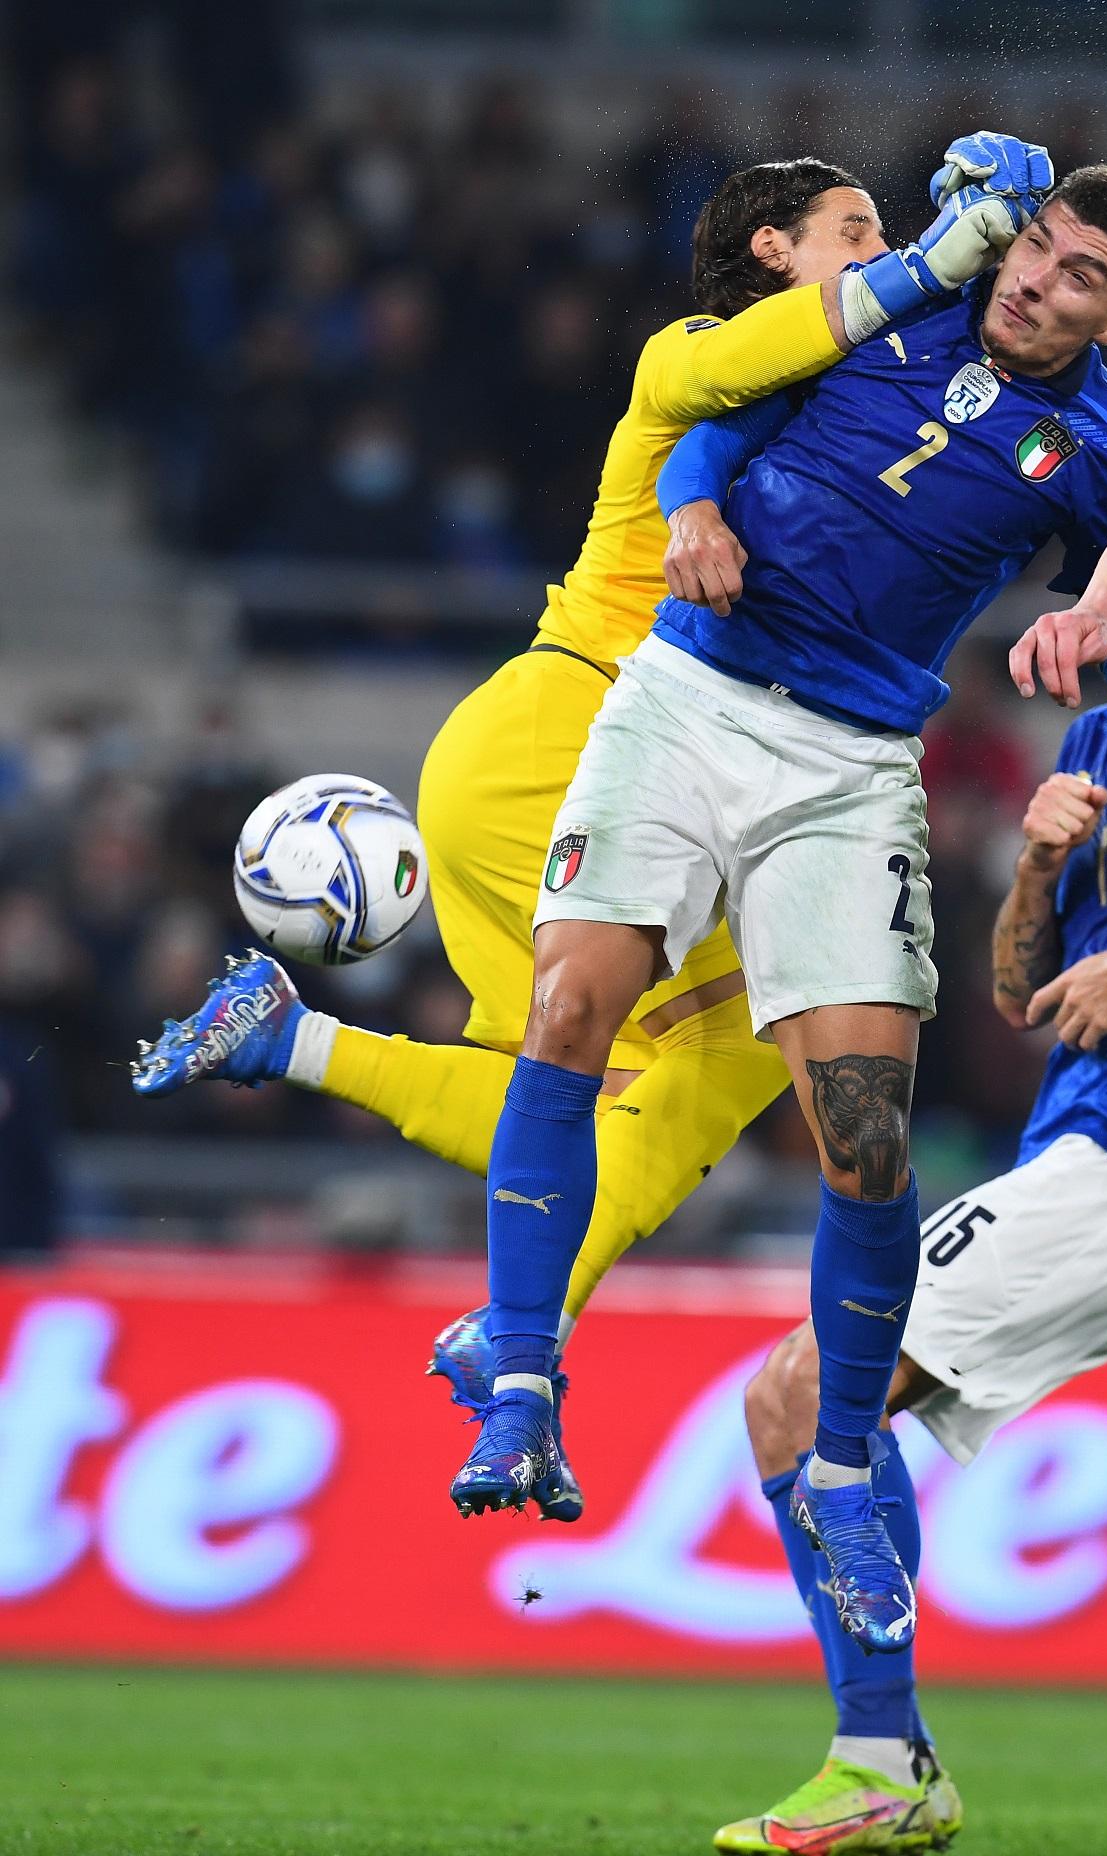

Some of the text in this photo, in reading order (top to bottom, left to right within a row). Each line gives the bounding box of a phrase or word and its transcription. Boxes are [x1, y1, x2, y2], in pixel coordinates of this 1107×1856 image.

[963, 375, 989, 398] CHAMPIONS
[966, 370, 993, 395] EUROPEAN
[947, 407, 962, 420] 2020
[1041, 421, 1073, 455] ITALIA
[878, 421, 949, 498] 2
[554, 838, 584, 853] ITALIA
[887, 853, 915, 936] 2
[921, 1201, 997, 1267] 15
